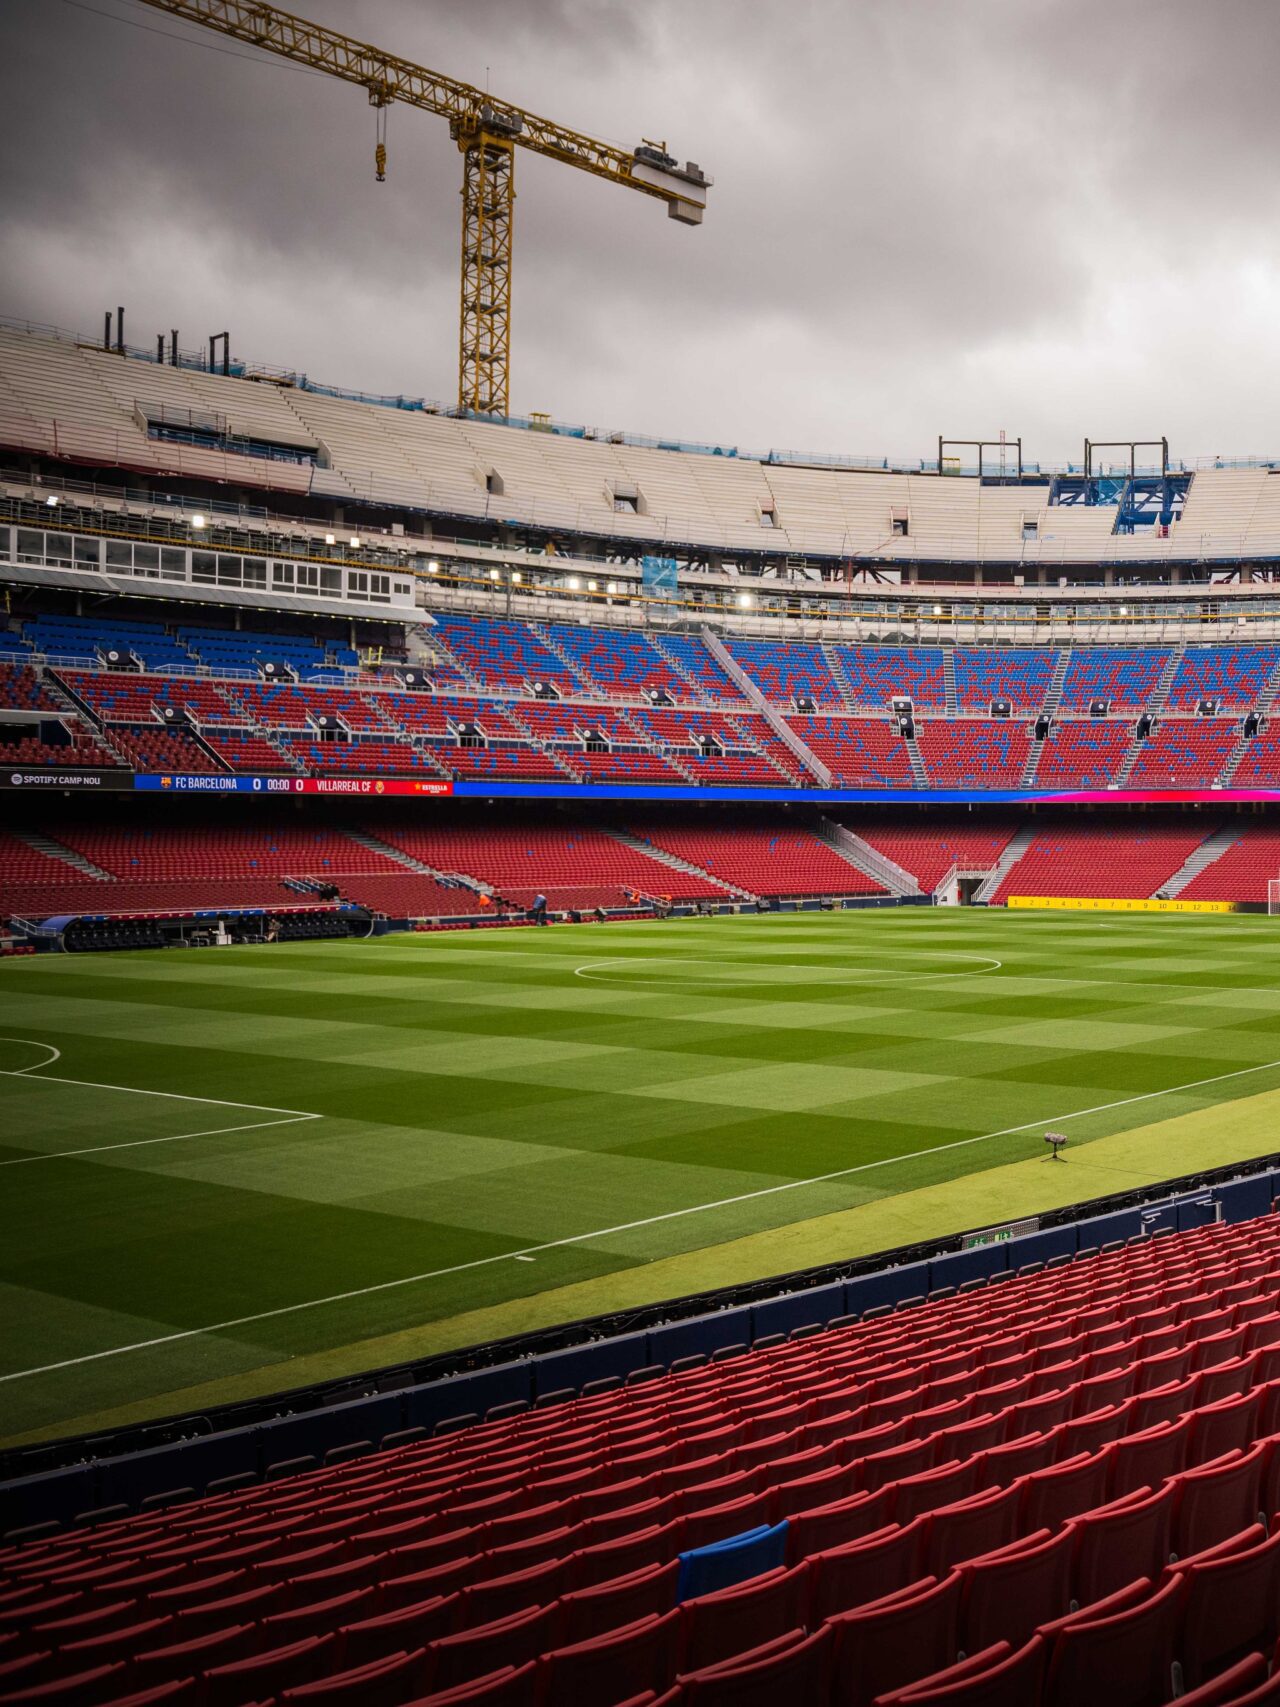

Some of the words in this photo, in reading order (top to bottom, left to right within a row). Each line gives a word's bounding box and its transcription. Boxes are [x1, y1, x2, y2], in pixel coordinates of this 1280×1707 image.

[23, 775, 58, 784] SPOTIFY
[59, 776, 82, 785] CAMP
[83, 777, 100, 785] NOU
[175, 777, 186, 788] FC
[188, 777, 237, 789] BARCELONA
[253, 778, 261, 790] 0
[267, 779, 290, 790] 00:00
[296, 779, 304, 791] 0
[316, 781, 360, 792] VILLARREAL
[361, 781, 371, 792] CF
